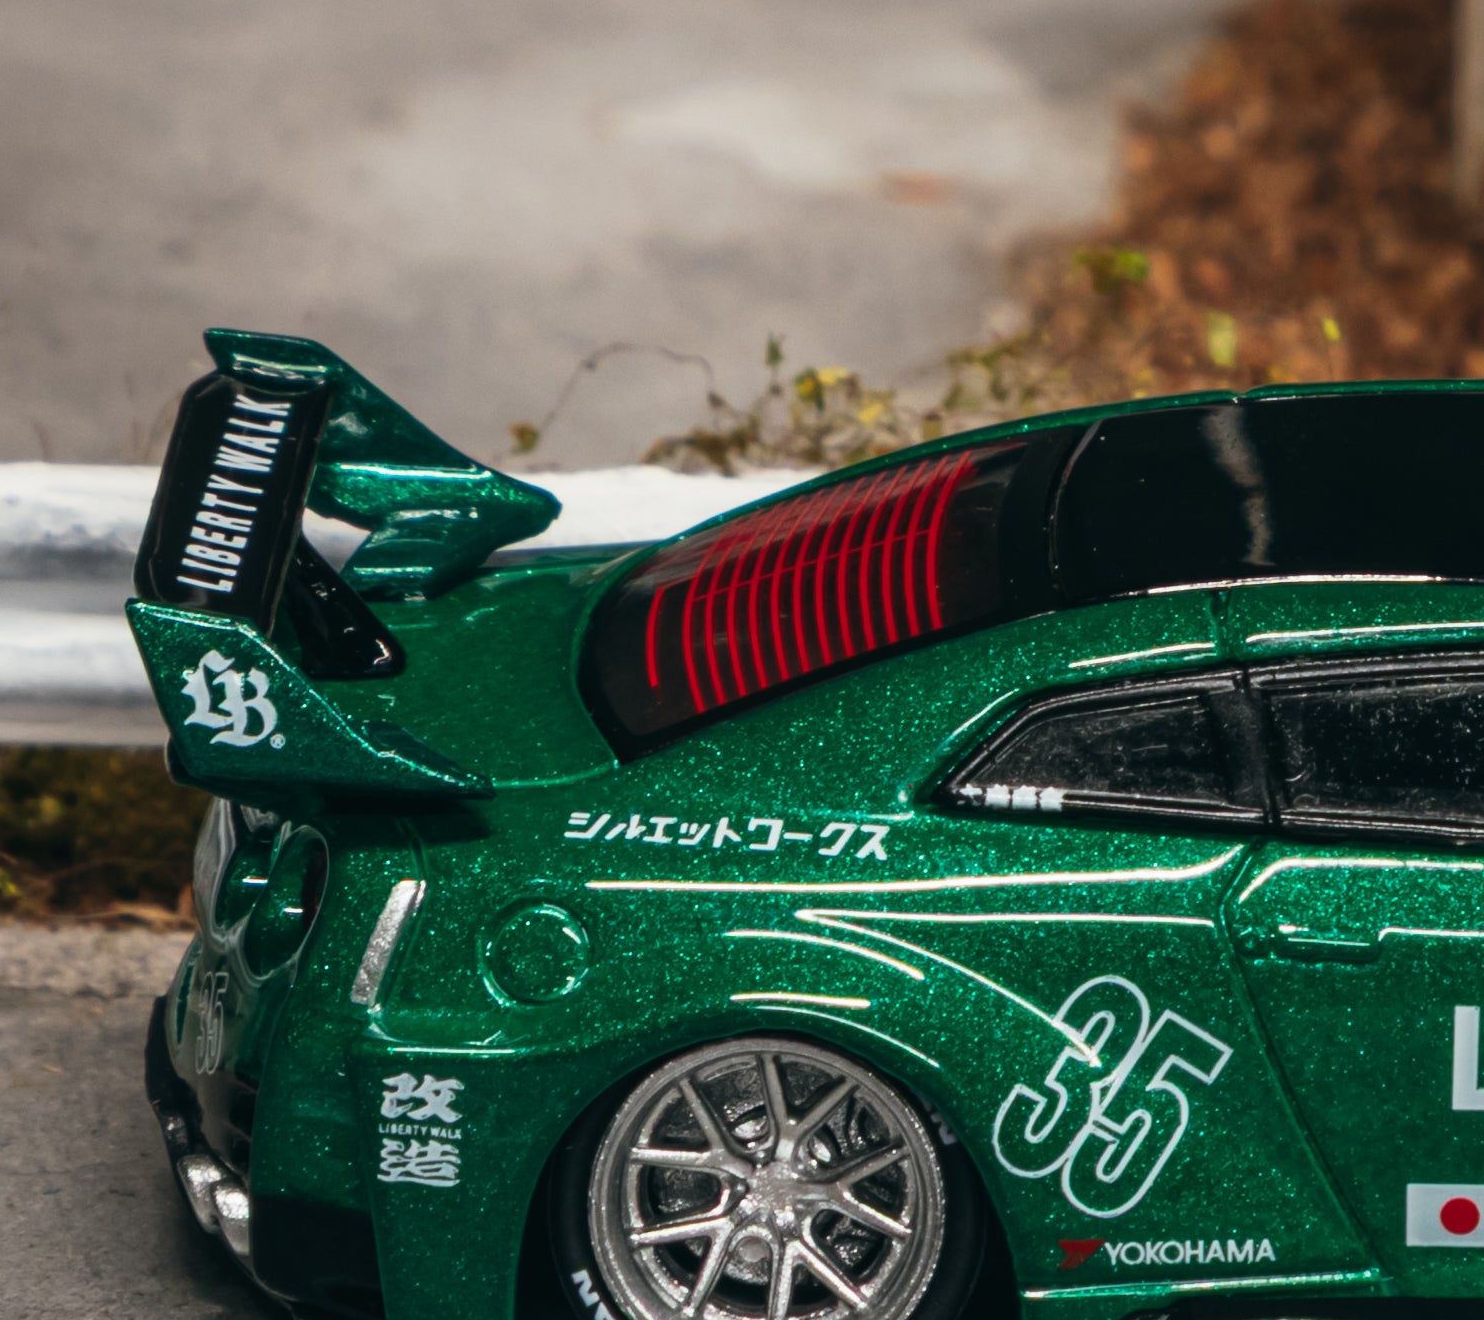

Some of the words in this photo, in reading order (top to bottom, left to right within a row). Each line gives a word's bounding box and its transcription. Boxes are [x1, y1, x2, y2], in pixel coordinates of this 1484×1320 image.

[215, 394, 292, 473] WALK
[177, 474, 265, 593] LIBERTY
[564, 811, 891, 861] シルエットワークス
[380, 1072, 465, 1124] 改
[991, 975, 1233, 1219] 35
[378, 1123, 428, 1136] LIBERTY
[430, 1126, 463, 1140] WALK
[1104, 1239, 1276, 1266] YOKOHAMA
